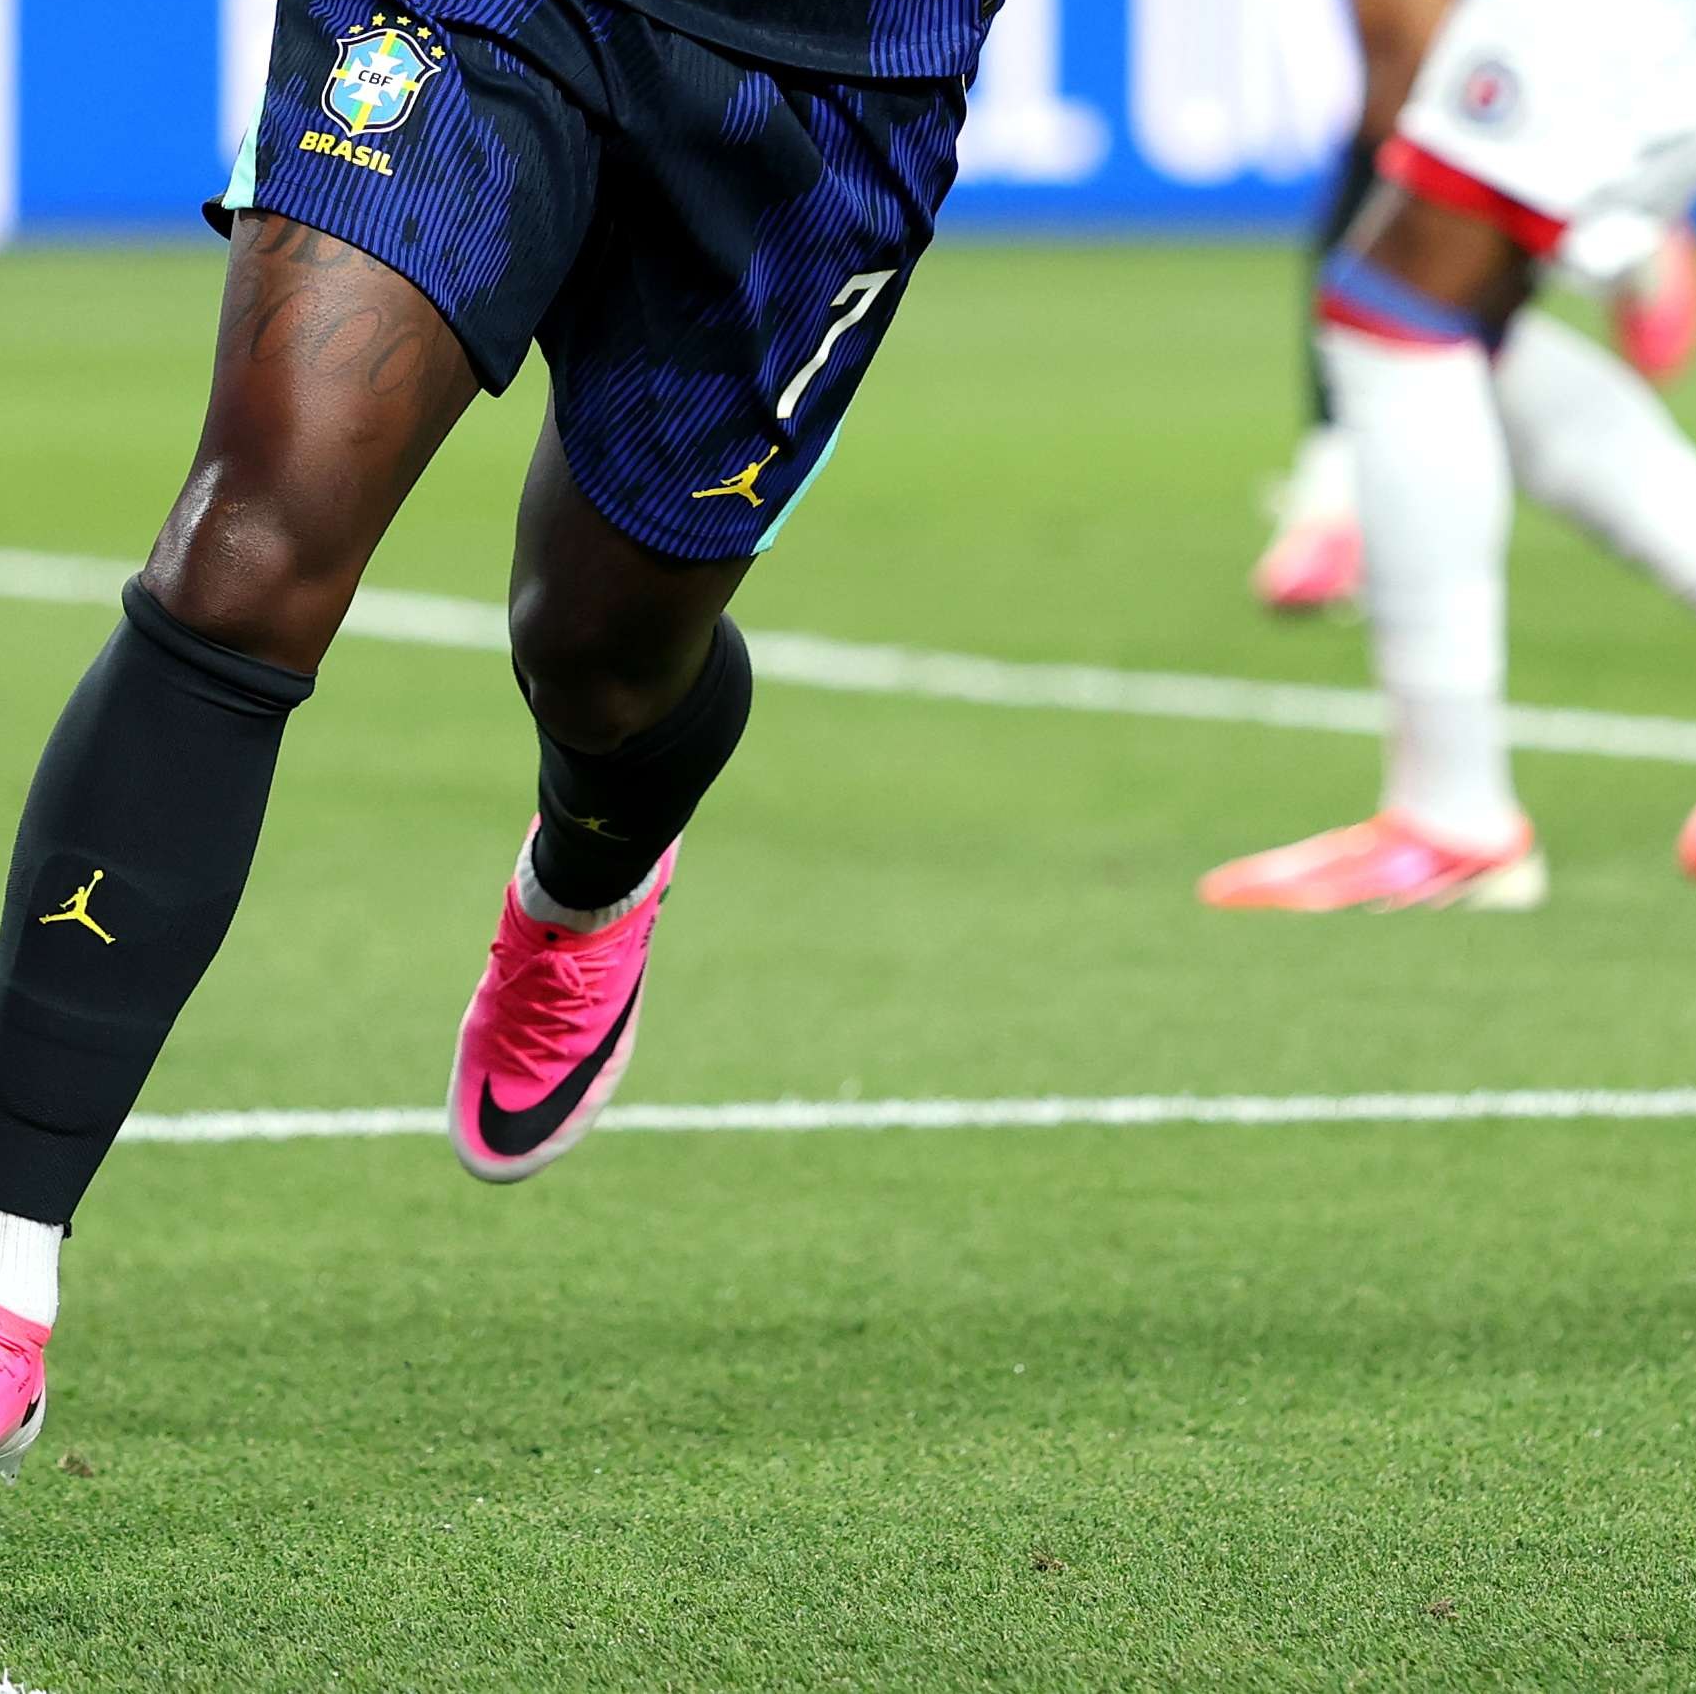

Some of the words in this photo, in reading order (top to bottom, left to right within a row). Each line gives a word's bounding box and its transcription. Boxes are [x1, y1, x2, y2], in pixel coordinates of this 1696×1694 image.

[358, 69, 393, 88] CBF
[299, 130, 394, 177] BRASIL
[777, 269, 897, 419] 7
